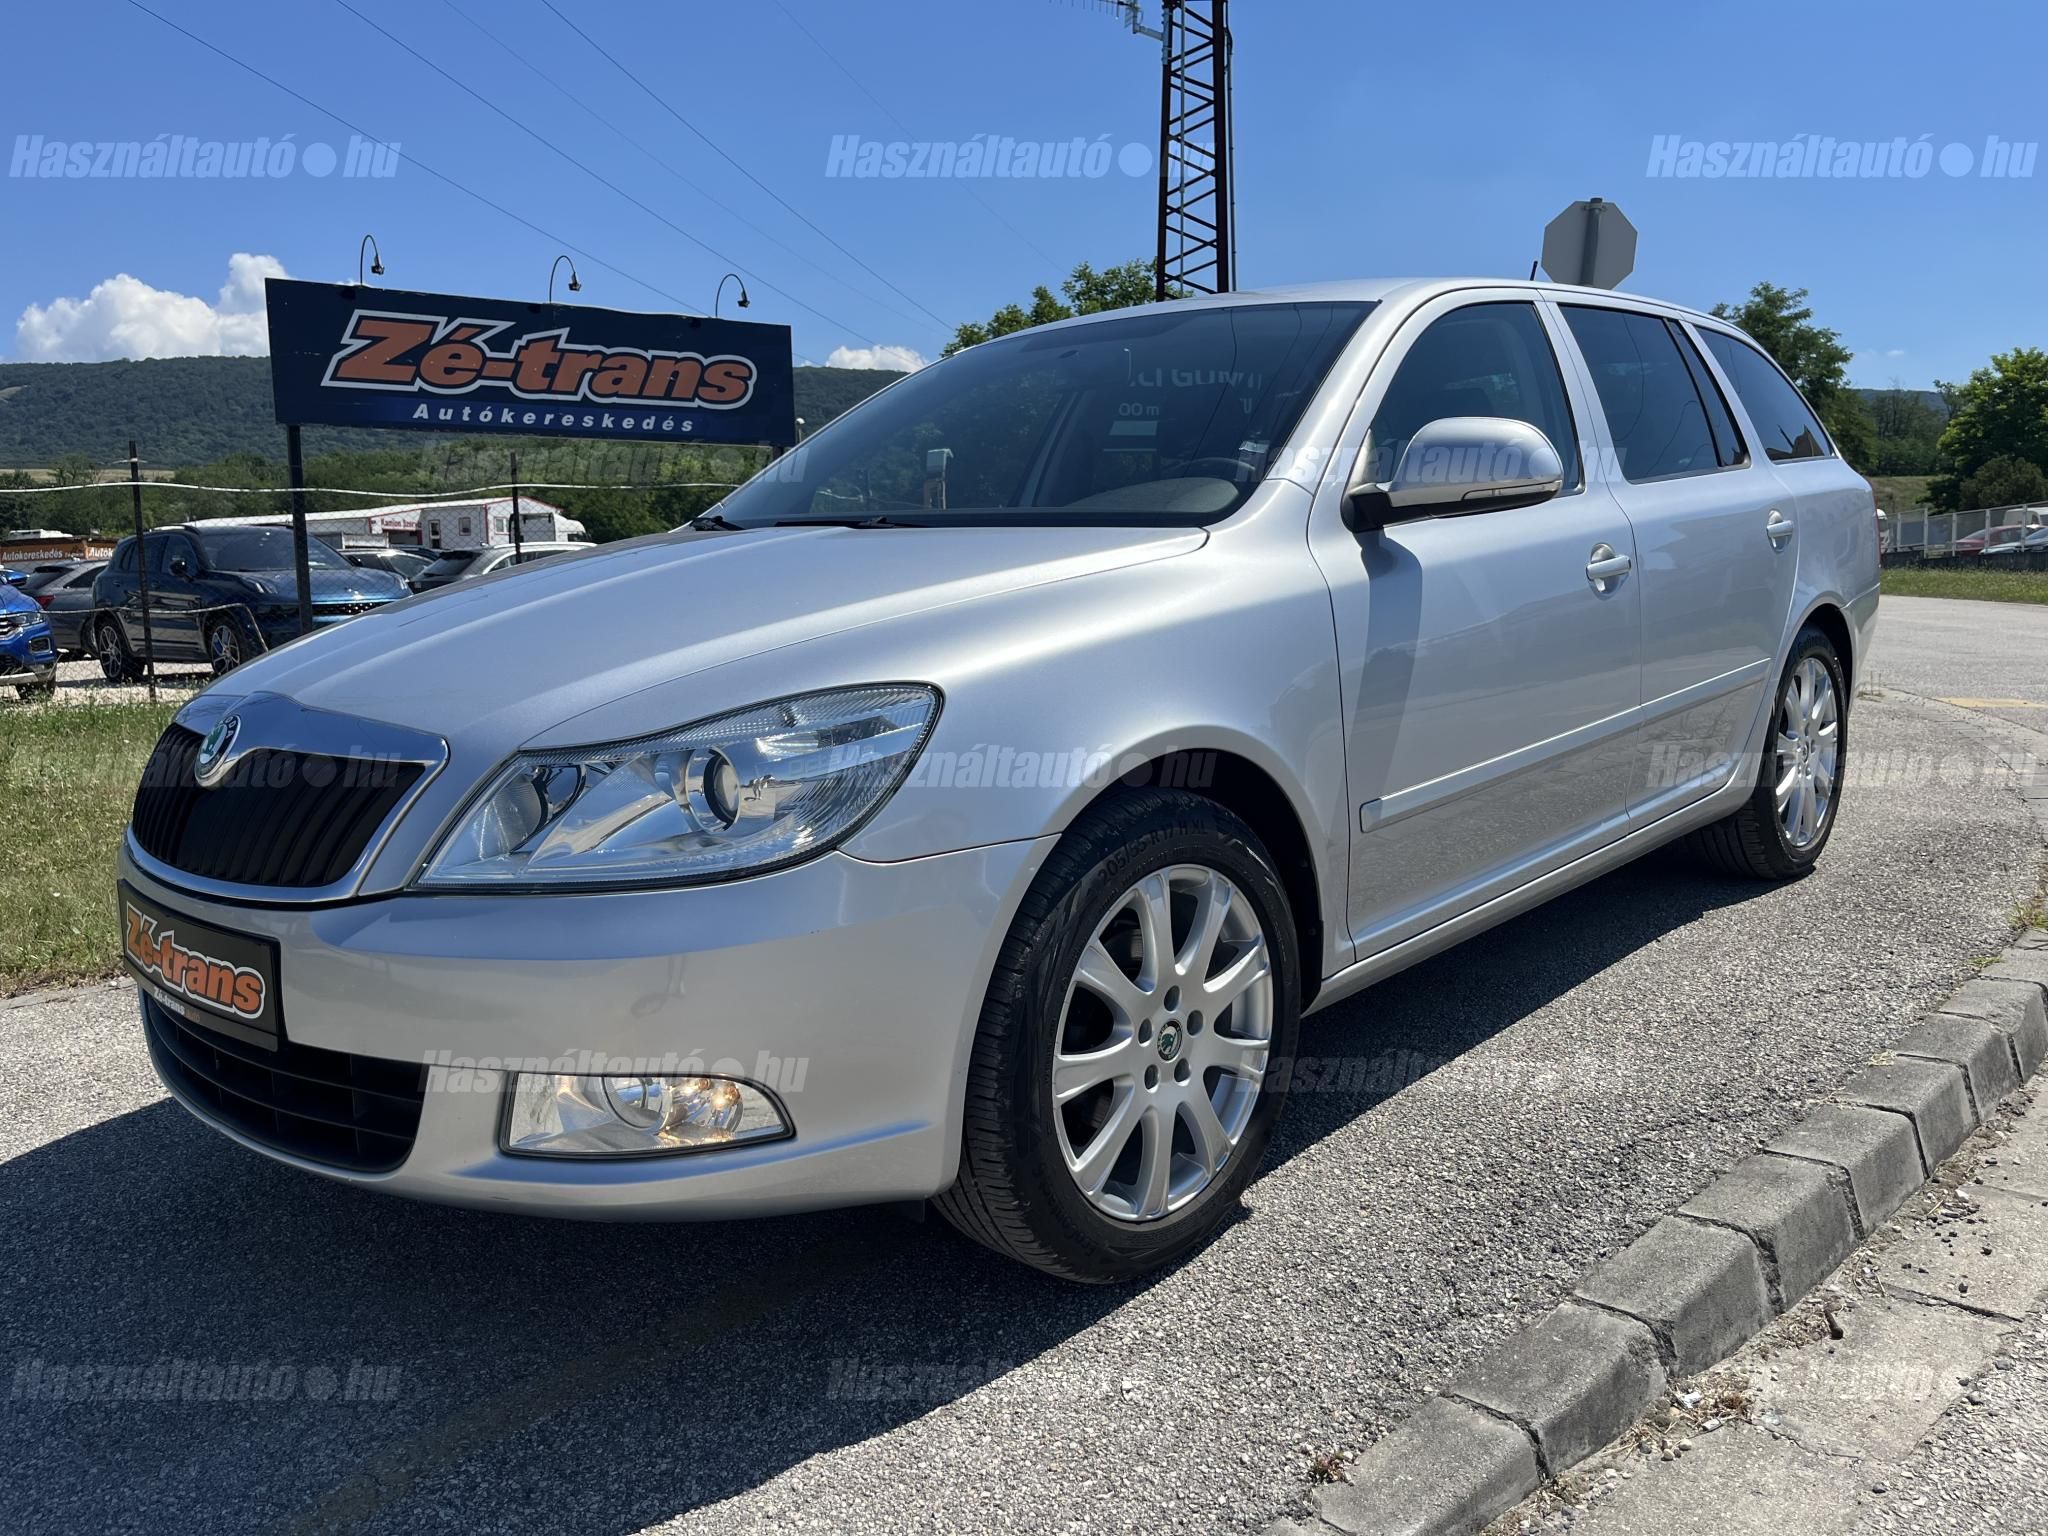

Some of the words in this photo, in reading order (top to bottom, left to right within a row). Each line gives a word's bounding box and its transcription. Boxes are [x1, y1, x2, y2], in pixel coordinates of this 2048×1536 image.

[324, 312, 755, 408] Zé-trans
[412, 402, 694, 432] Autókereskedés
[127, 902, 264, 1018] Zé-trans
